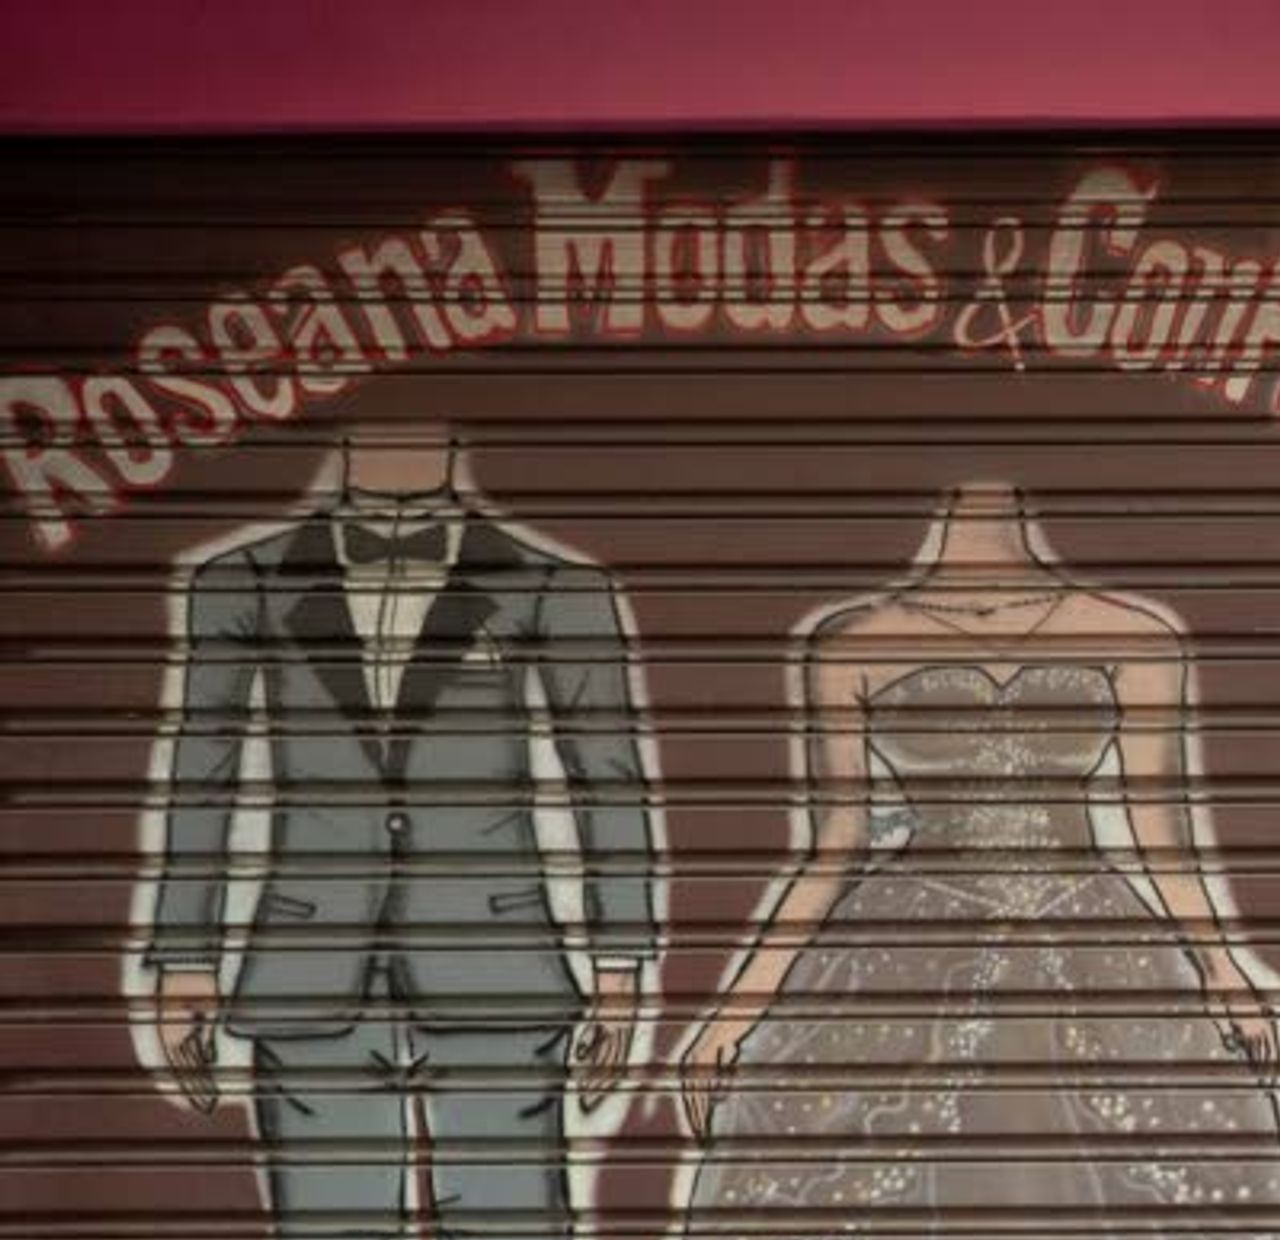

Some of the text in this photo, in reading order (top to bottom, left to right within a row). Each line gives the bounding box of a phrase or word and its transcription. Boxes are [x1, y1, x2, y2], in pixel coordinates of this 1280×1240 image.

[0, 208, 517, 550] Roseana
[508, 150, 950, 338] Modas
[953, 215, 1038, 372] &
